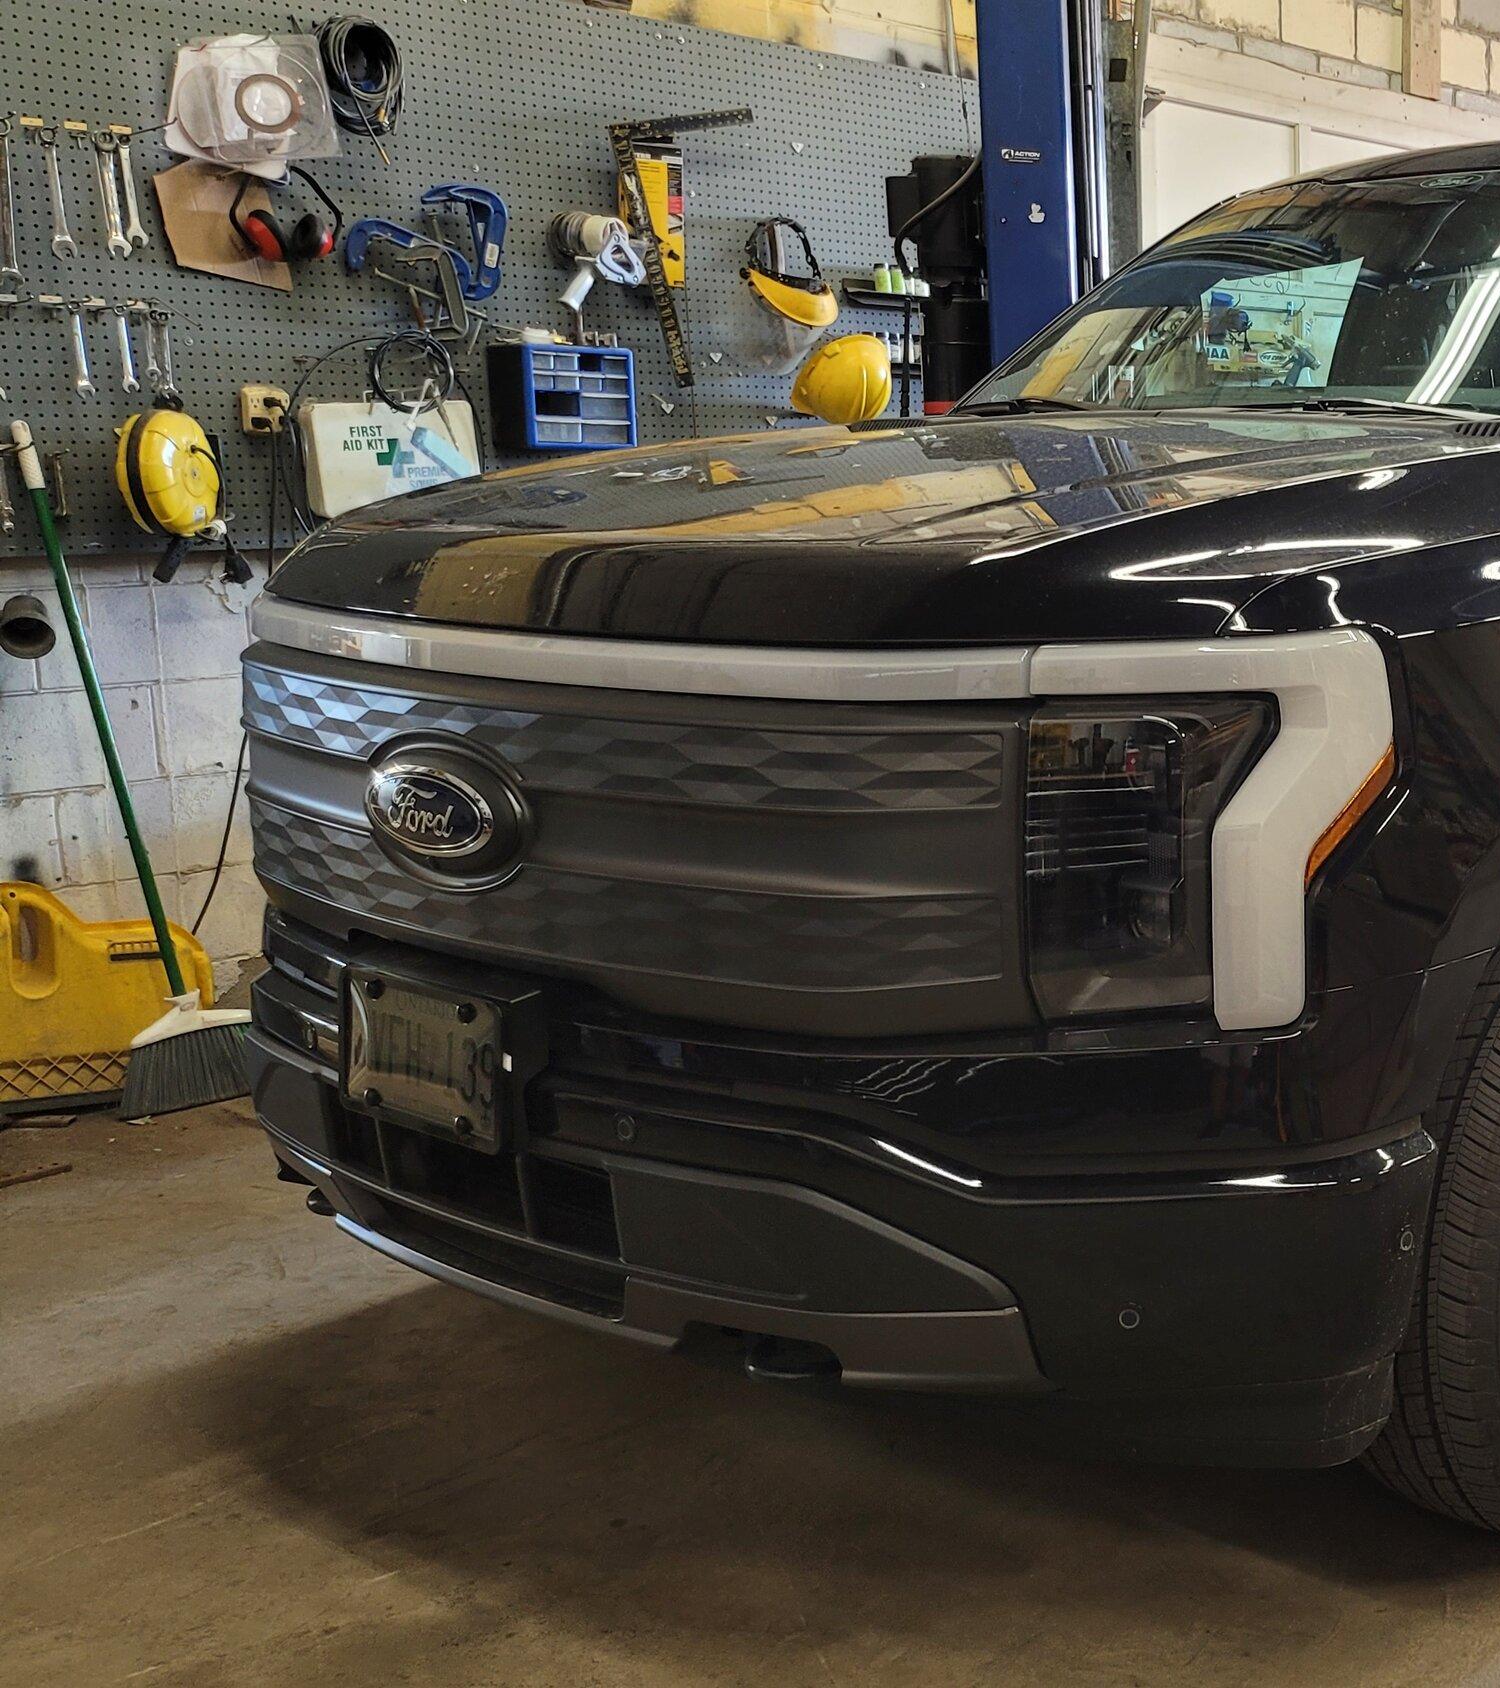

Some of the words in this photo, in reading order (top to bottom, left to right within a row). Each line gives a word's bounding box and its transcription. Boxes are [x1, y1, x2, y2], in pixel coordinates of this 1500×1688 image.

[1014, 150, 1041, 158] ACTION
[350, 425, 382, 438] FIRST
[343, 438, 363, 451] AID
[366, 438, 385, 450] KIT
[387, 783, 455, 838] Ford
